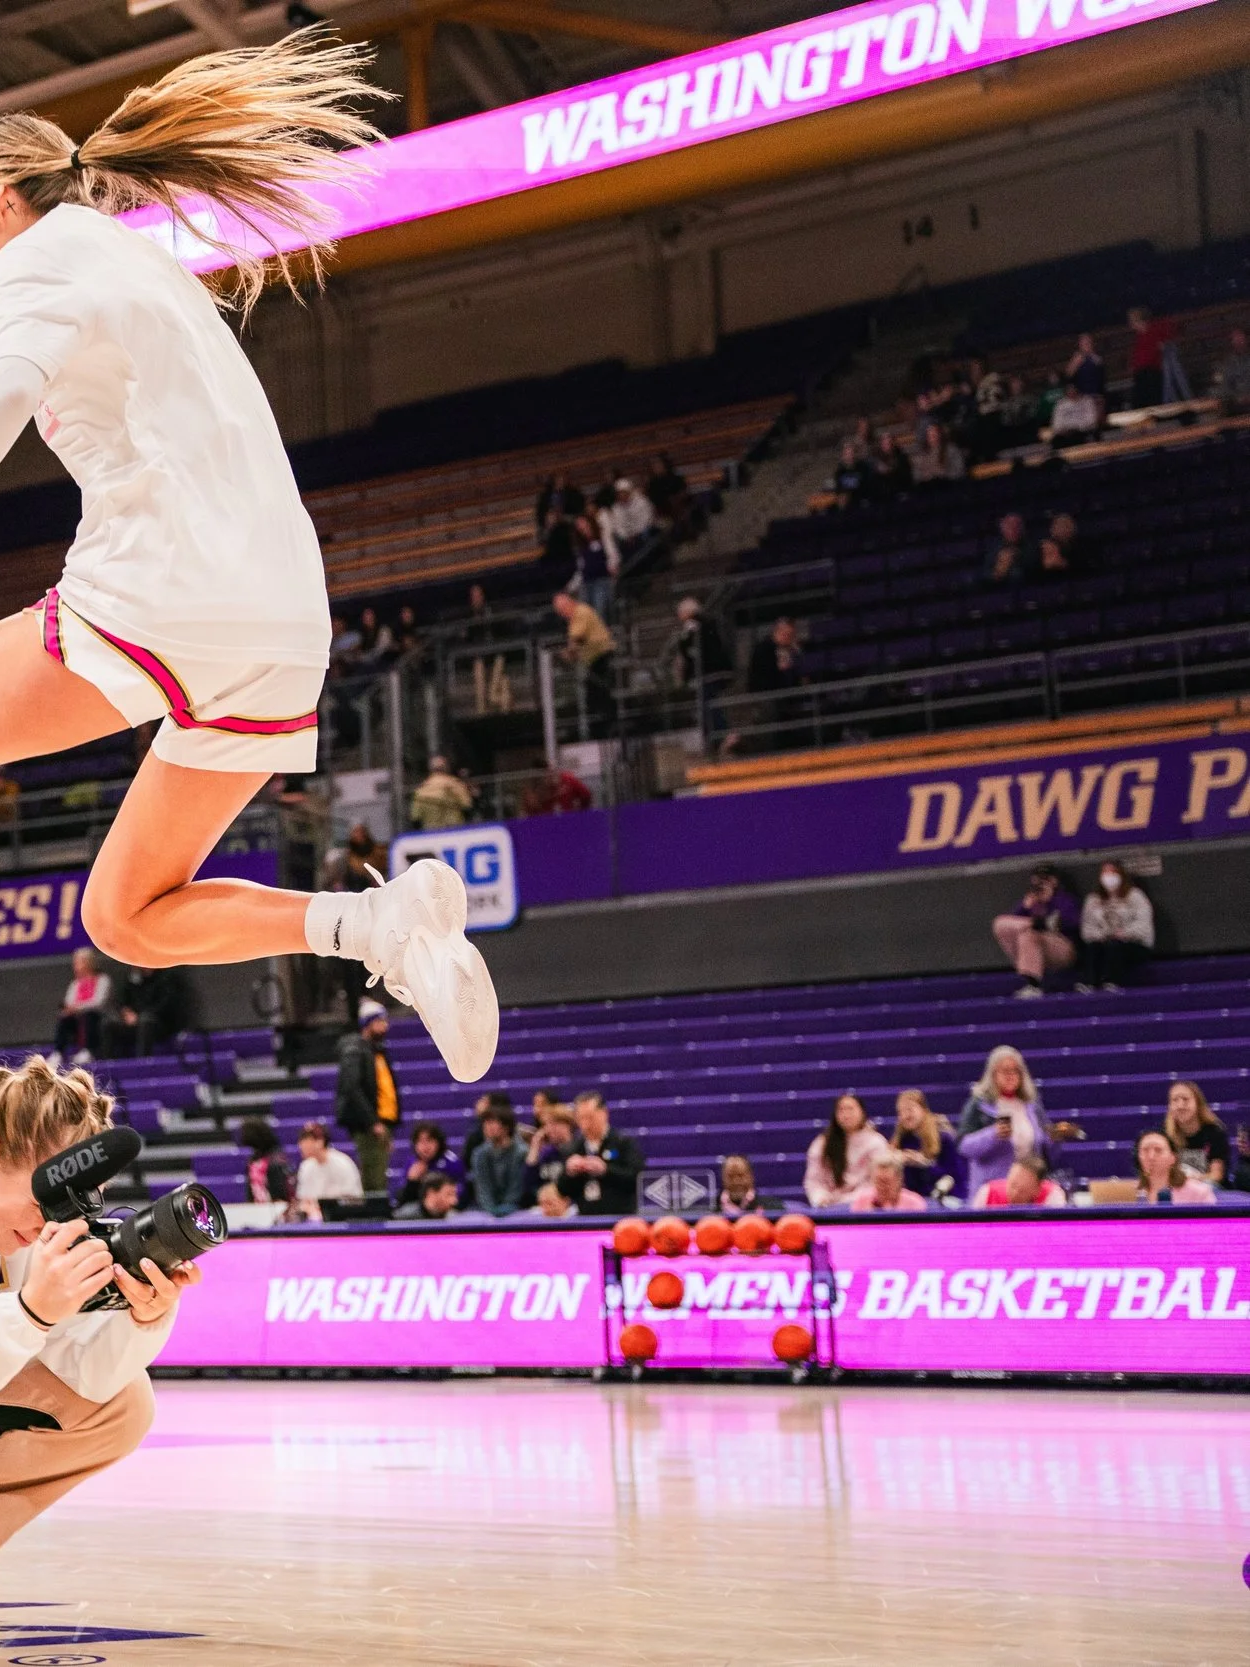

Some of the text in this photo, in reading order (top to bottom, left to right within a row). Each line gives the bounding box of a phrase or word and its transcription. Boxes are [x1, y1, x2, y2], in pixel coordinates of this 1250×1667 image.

[520, 0, 988, 175] WASHINGTON
[899, 757, 1159, 852] DAWG
[264, 1273, 592, 1322] WASHINGTON
[857, 1267, 1250, 1321] BASKETBAL
